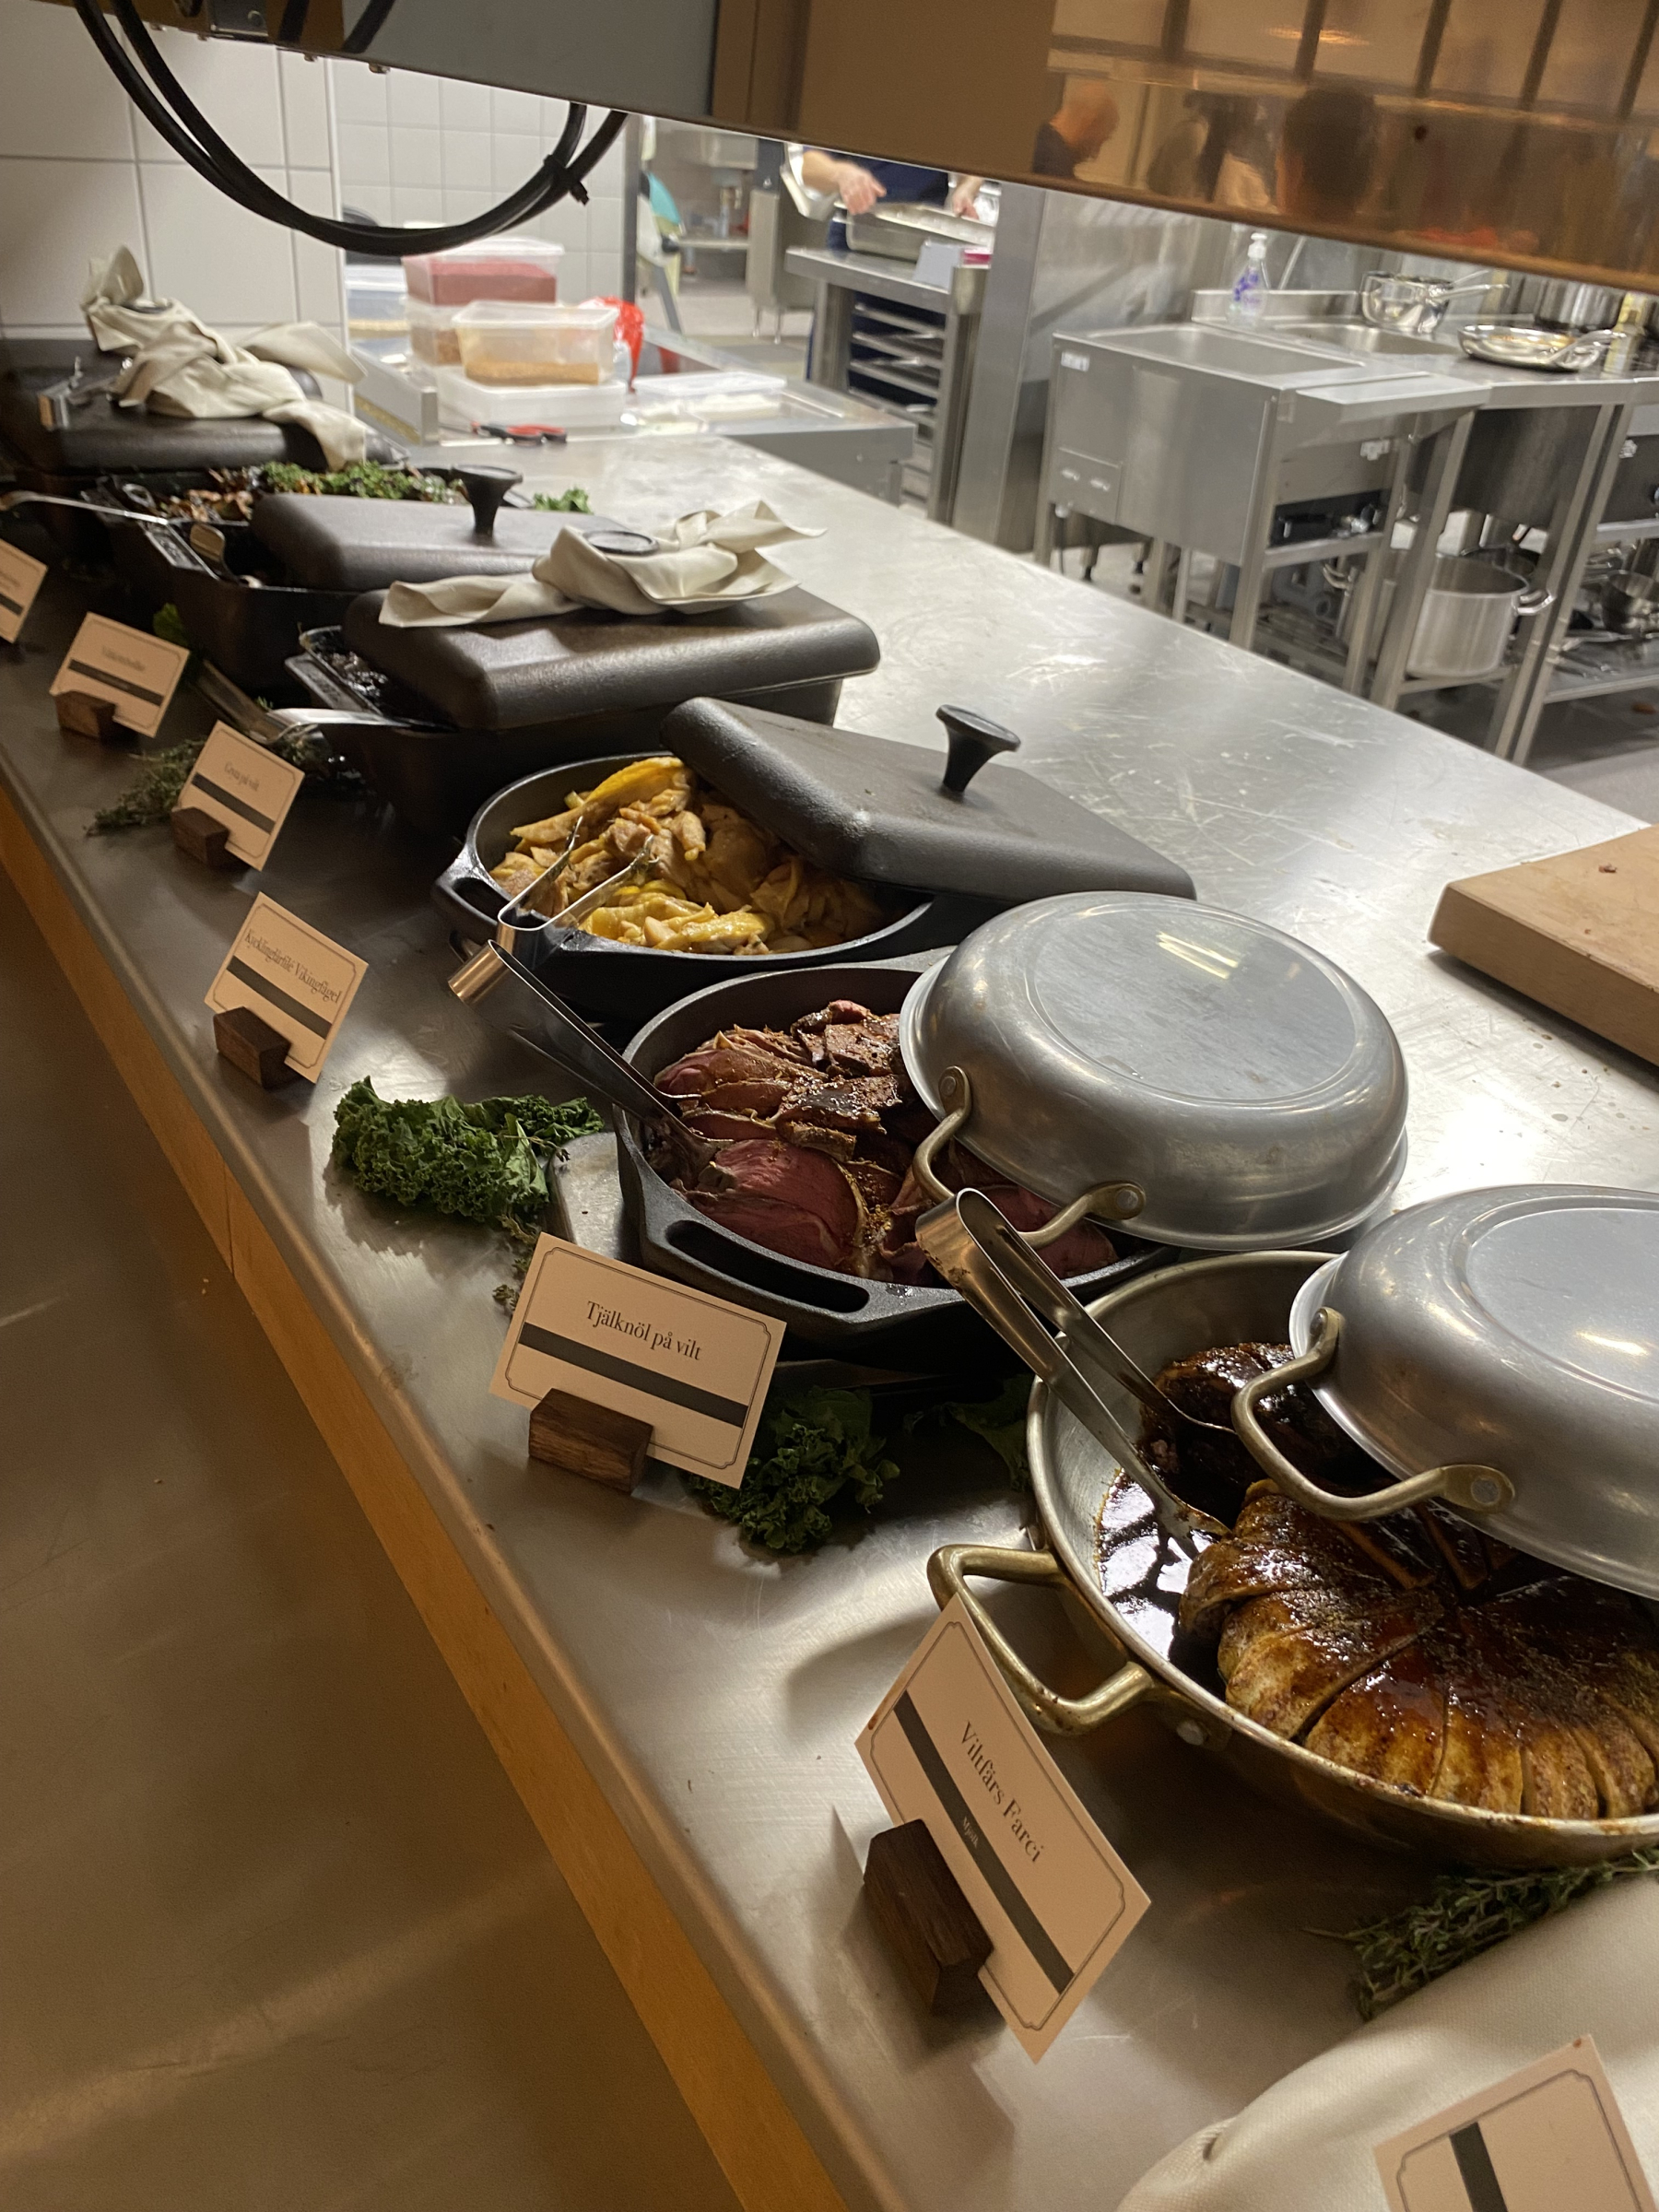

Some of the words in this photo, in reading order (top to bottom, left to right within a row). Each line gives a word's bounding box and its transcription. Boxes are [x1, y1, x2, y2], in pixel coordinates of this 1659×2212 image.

[587, 1300, 652, 1342] Tjälknöl
[650, 1326, 673, 1351] på
[677, 1334, 701, 1360] vilt
[961, 1721, 1005, 1805] Viltfärs
[1003, 1799, 1044, 1862] Farci
